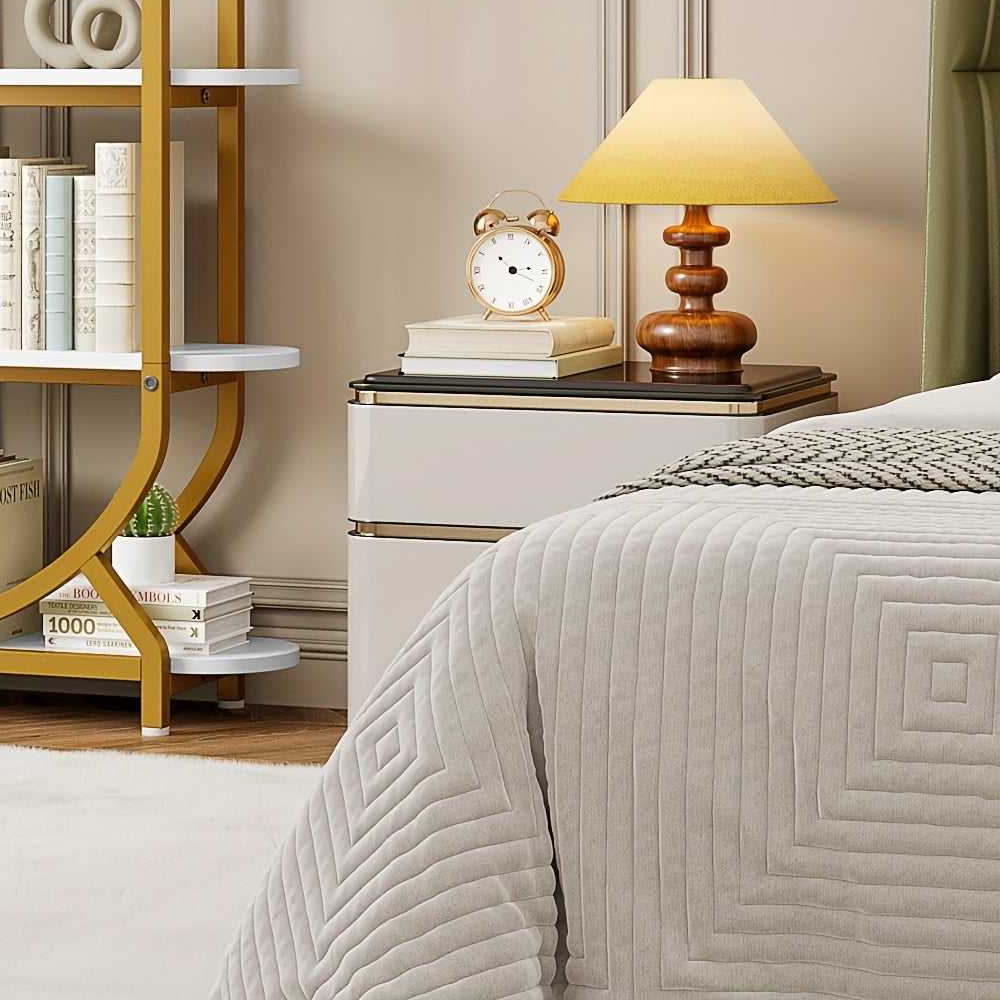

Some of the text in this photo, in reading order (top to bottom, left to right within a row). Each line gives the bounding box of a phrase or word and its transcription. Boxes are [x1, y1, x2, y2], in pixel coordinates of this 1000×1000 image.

[19, 480, 40, 501] FISH
[73, 588, 100, 599] BOO
[134, 591, 182, 603] MBOLS
[47, 602, 98, 611] TEXTILE DESIGNERS
[48, 616, 96, 635] 1000
[103, 640, 133, 649] SAARINEN
